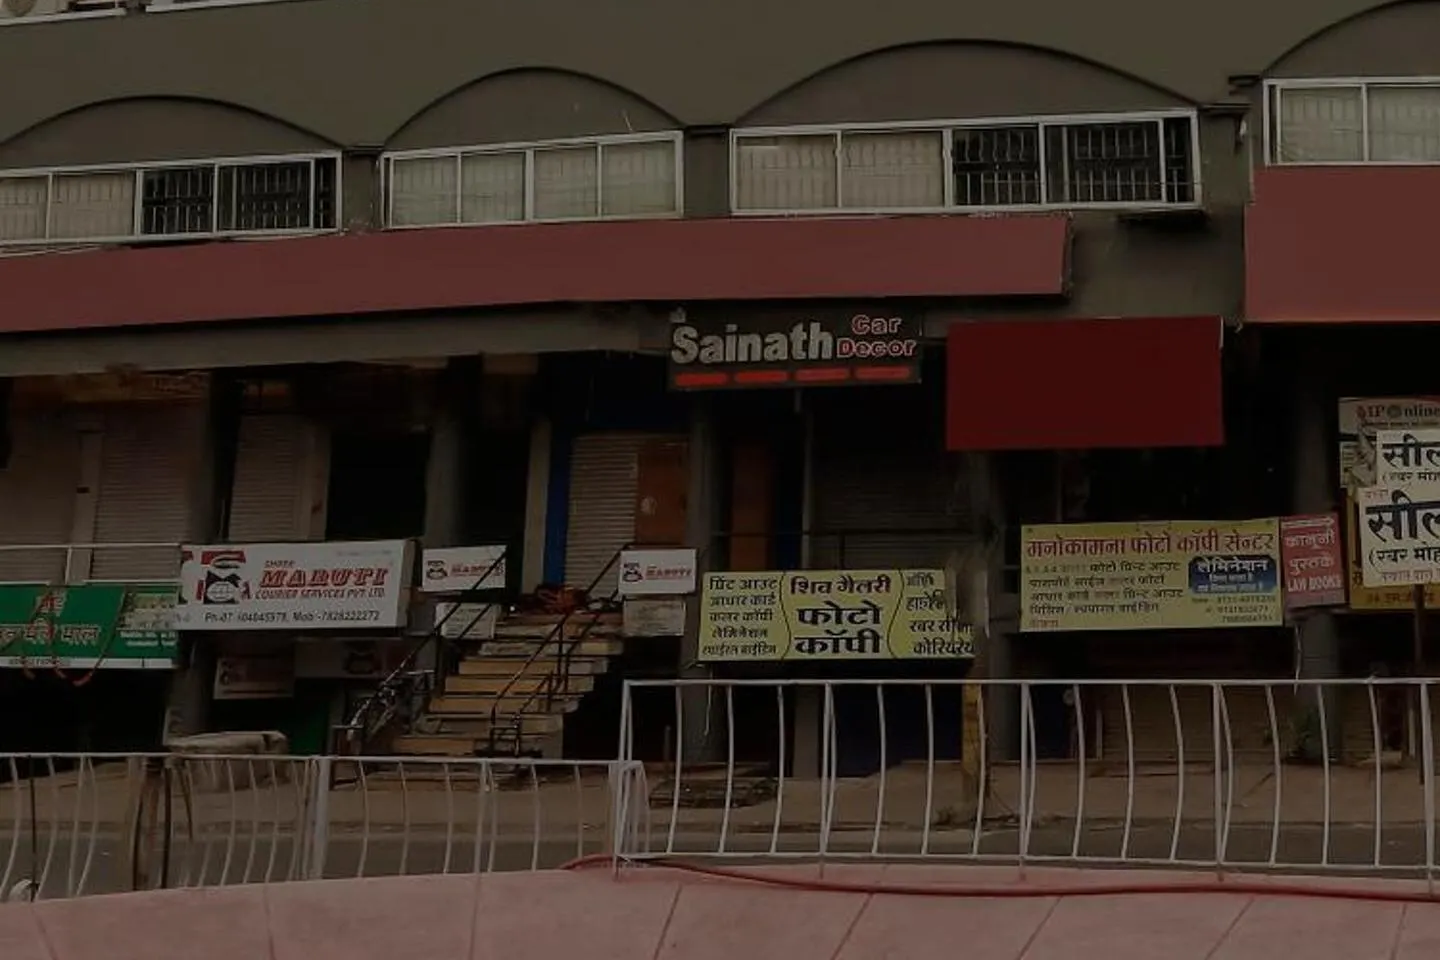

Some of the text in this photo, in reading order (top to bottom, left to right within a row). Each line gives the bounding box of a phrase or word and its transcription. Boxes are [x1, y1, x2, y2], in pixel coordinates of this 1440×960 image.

[851, 314, 902, 335] Car
[671, 321, 835, 364] Sainath
[836, 337, 917, 358] Decor
[1026, 534, 1125, 557] मनोकामना
[1130, 530, 1170, 554] फोटो
[1177, 527, 1218, 552] कॉपी
[259, 568, 389, 588] MARUTI
[790, 575, 832, 594] शिव
[1287, 578, 1306, 592] LAW
[1308, 575, 1342, 591] BOOKS
[255, 589, 299, 600] COURIER
[301, 588, 346, 599] SERVICES
[796, 600, 883, 625] फोटो
[794, 628, 883, 654] कॉपी
